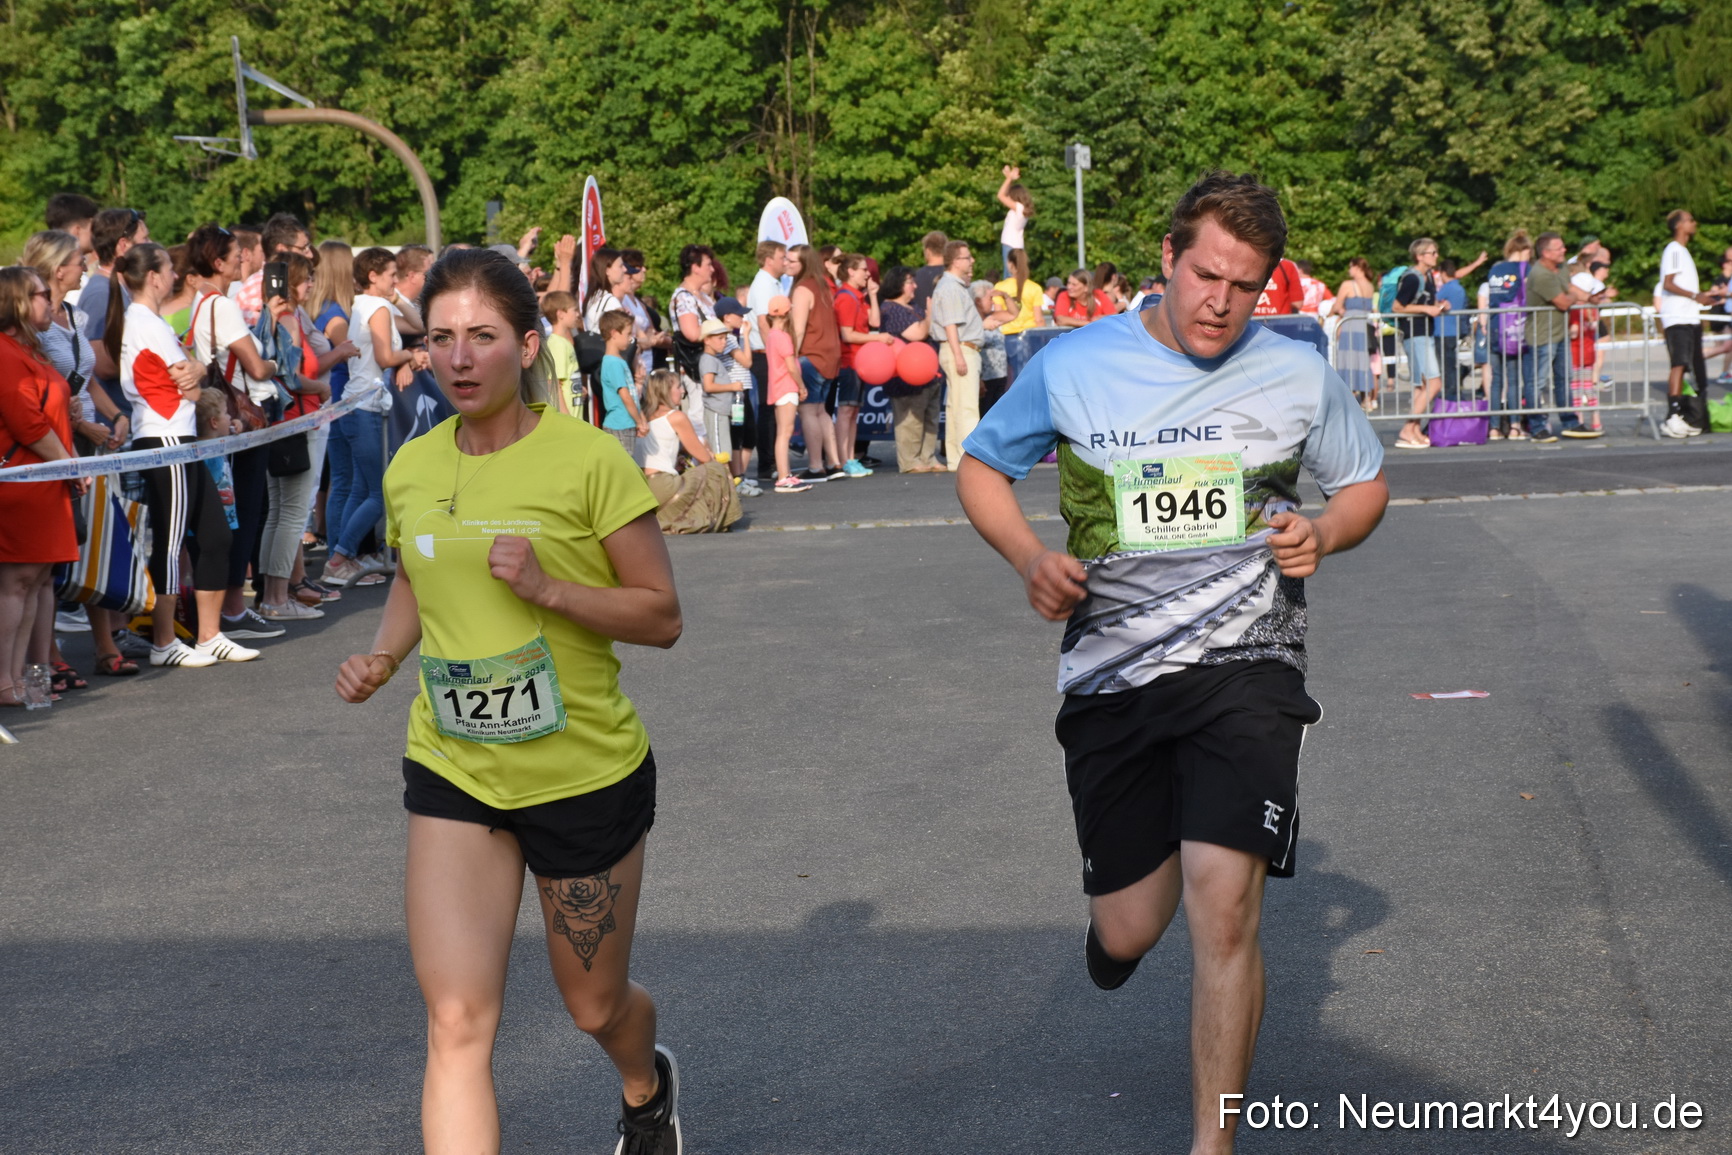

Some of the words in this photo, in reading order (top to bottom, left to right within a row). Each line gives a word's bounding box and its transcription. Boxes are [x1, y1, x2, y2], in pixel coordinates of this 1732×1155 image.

[1133, 474, 1183, 486] firmenlauf
[1212, 477, 1234, 487] 2019
[1132, 488, 1227, 524] 1946
[1145, 524, 1180, 534] Schiller
[1183, 521, 1218, 532] Gabriel
[525, 663, 546, 679] 2019
[442, 674, 493, 684] firmenlauf
[444, 678, 540, 720] 1271
[456, 718, 477, 729] Pfau
[480, 713, 541, 729] Ann-Kathrin
[466, 728, 496, 736] Klinikum
[497, 725, 532, 736] Neumarkt
